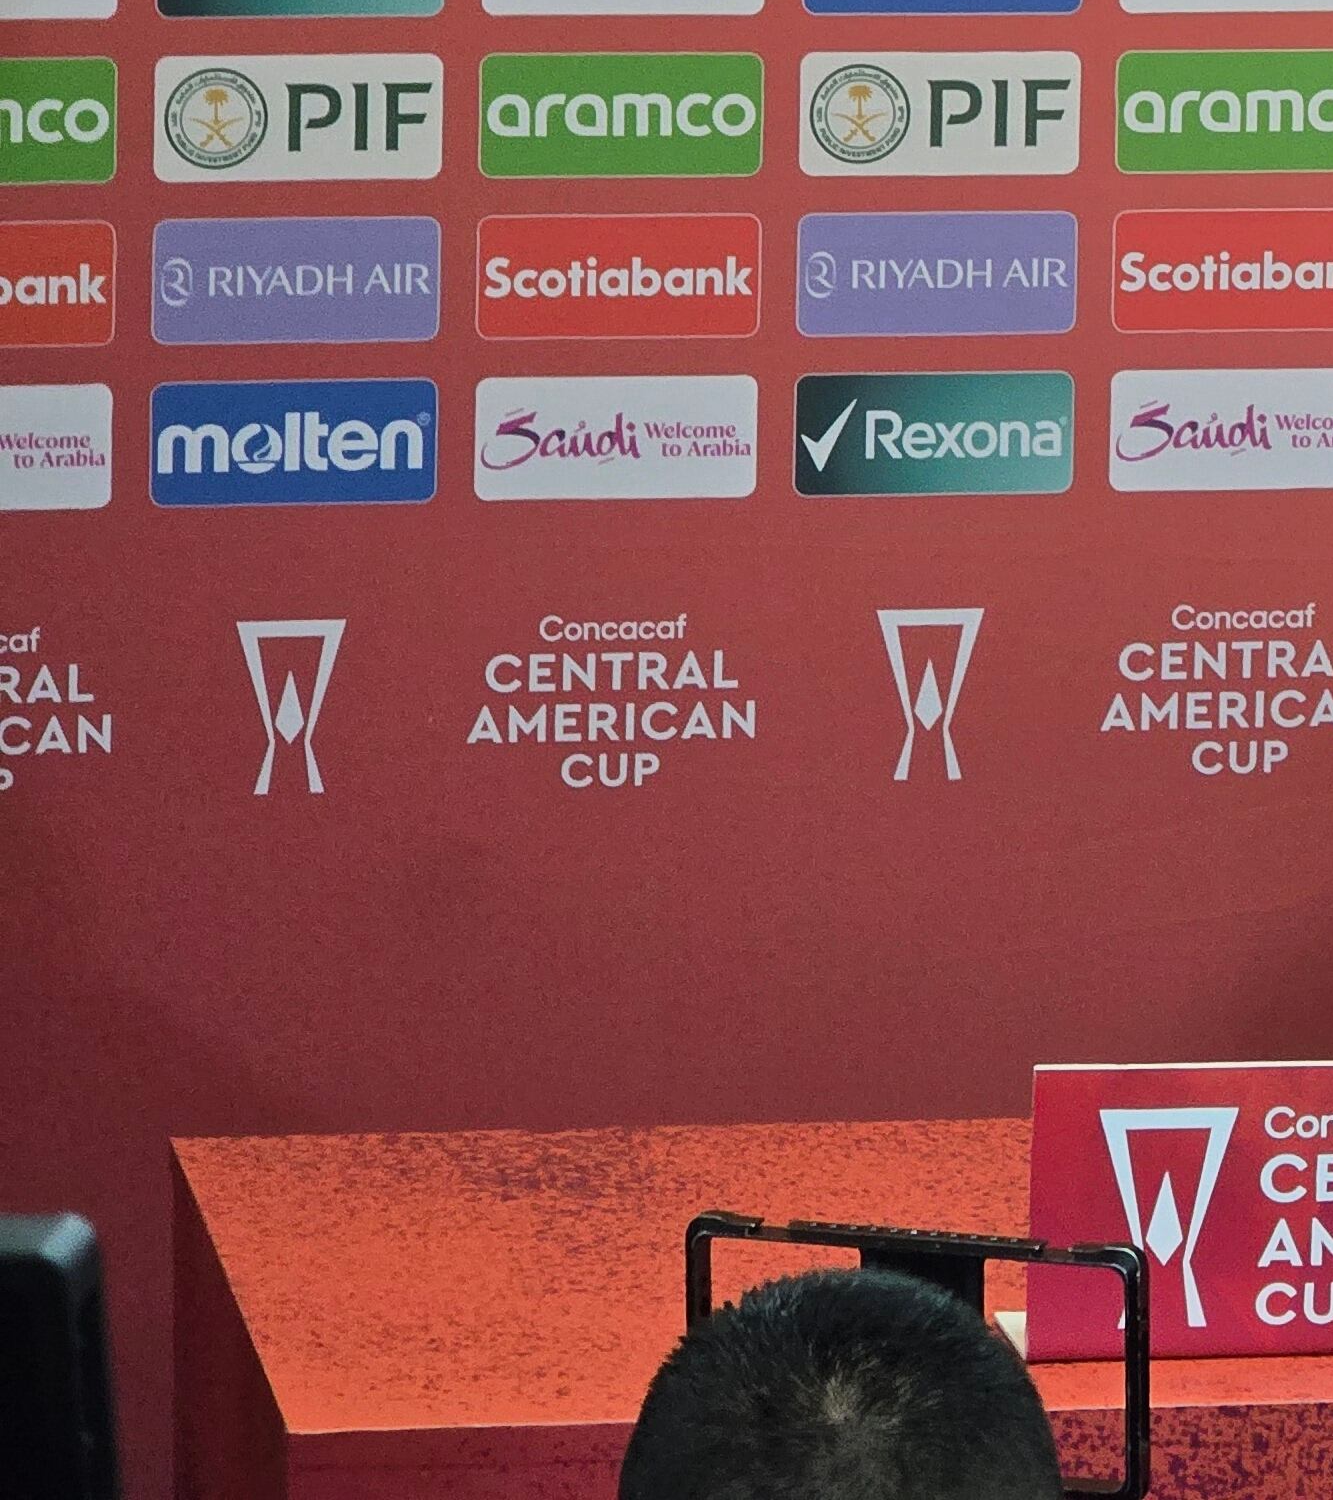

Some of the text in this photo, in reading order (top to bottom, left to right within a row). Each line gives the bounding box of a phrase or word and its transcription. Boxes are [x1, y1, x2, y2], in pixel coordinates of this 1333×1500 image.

[286, 83, 432, 151] PIF
[487, 93, 756, 137] aramco
[928, 80, 1070, 147] PIF
[209, 264, 430, 296] RIYADH AIR
[485, 256, 752, 298] Scotiabank
[852, 258, 1067, 288] RIYADH AIR
[157, 412, 423, 473] molten
[865, 410, 1066, 459] Rexona
[540, 614, 687, 642] Concacaf
[1172, 603, 1315, 630] Concacaf
[485, 650, 738, 692] CENTRAL
[467, 700, 755, 743] AMERICAN
[561, 753, 659, 787] CUP
[1192, 740, 1288, 774] CUP
